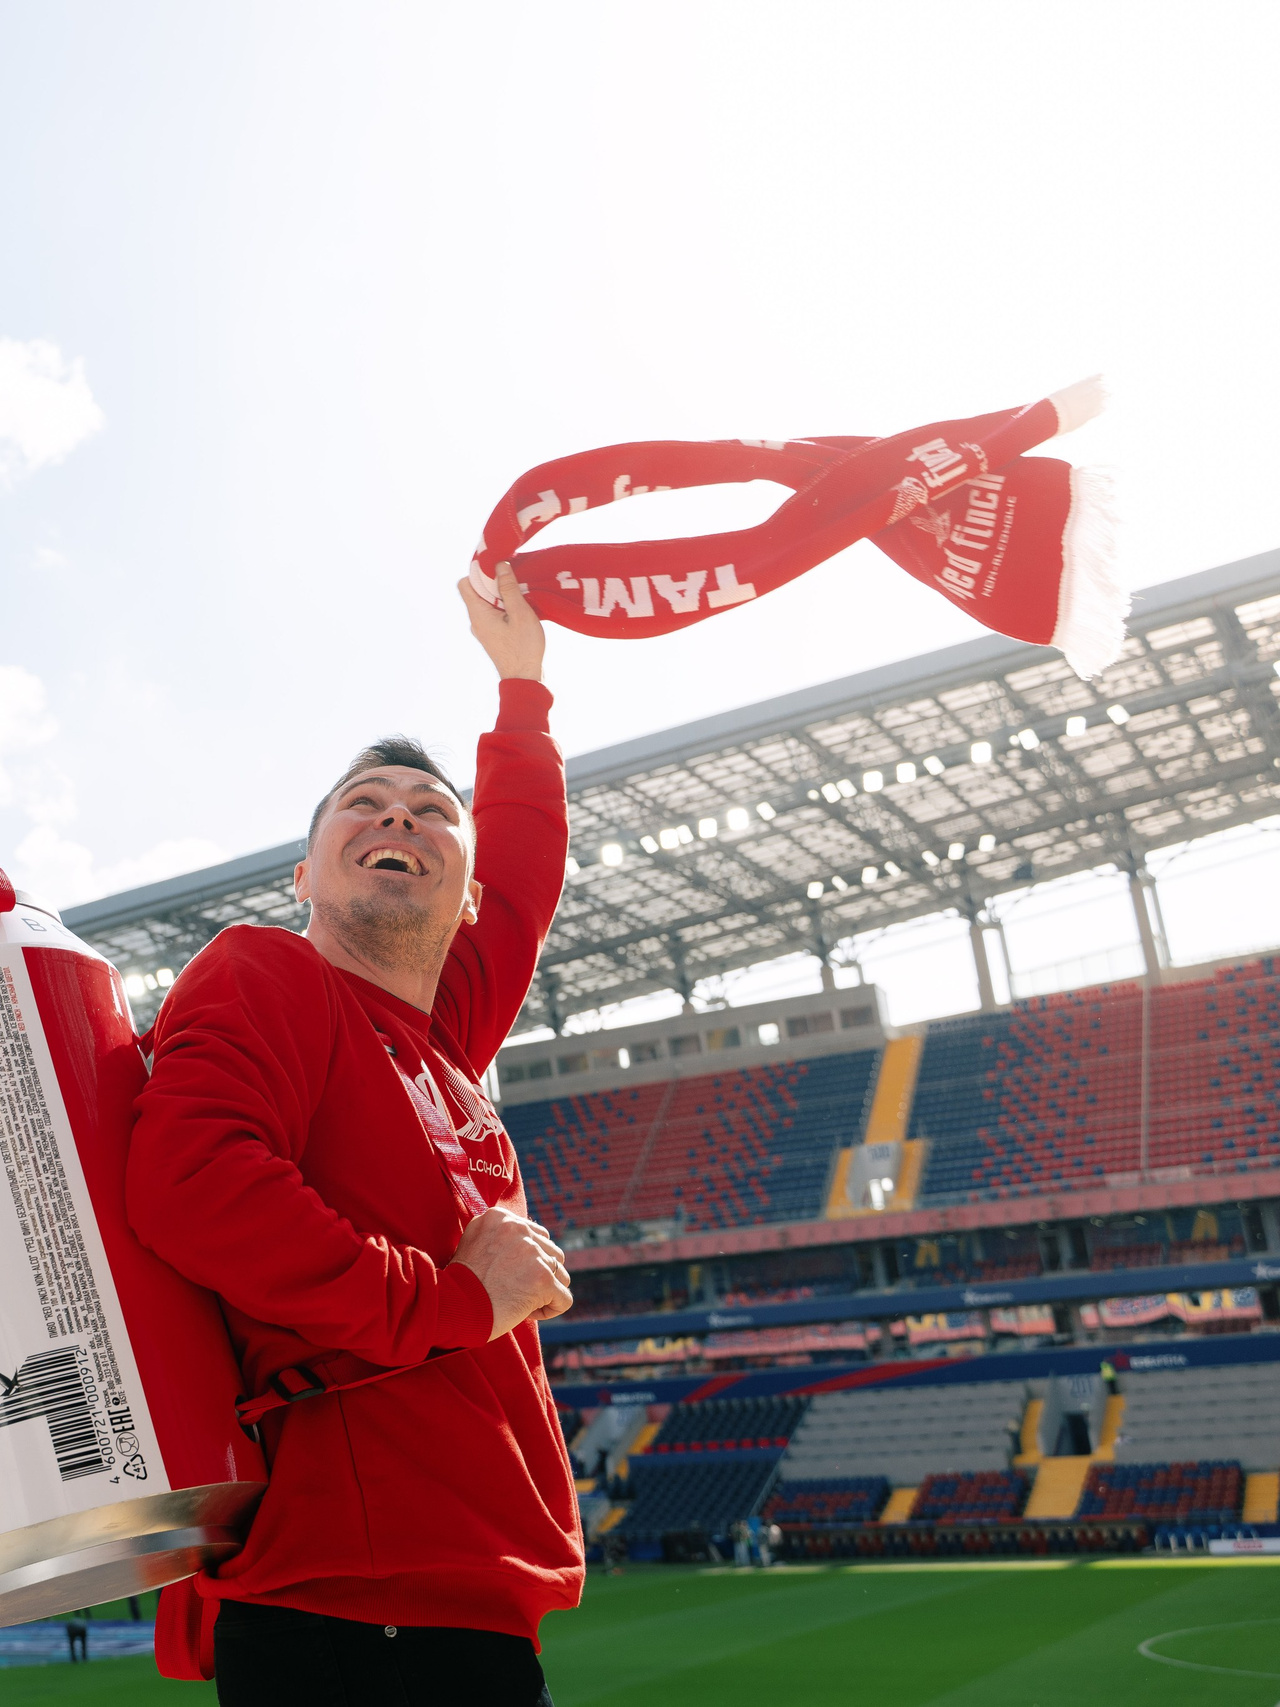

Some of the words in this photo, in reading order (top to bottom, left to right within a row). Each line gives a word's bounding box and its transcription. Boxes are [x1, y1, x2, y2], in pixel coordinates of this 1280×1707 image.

[468, 1157, 510, 1179] LCOHOL
[75, 1348, 99, 1403] 000912
[92, 1410, 115, 1465] 600721
